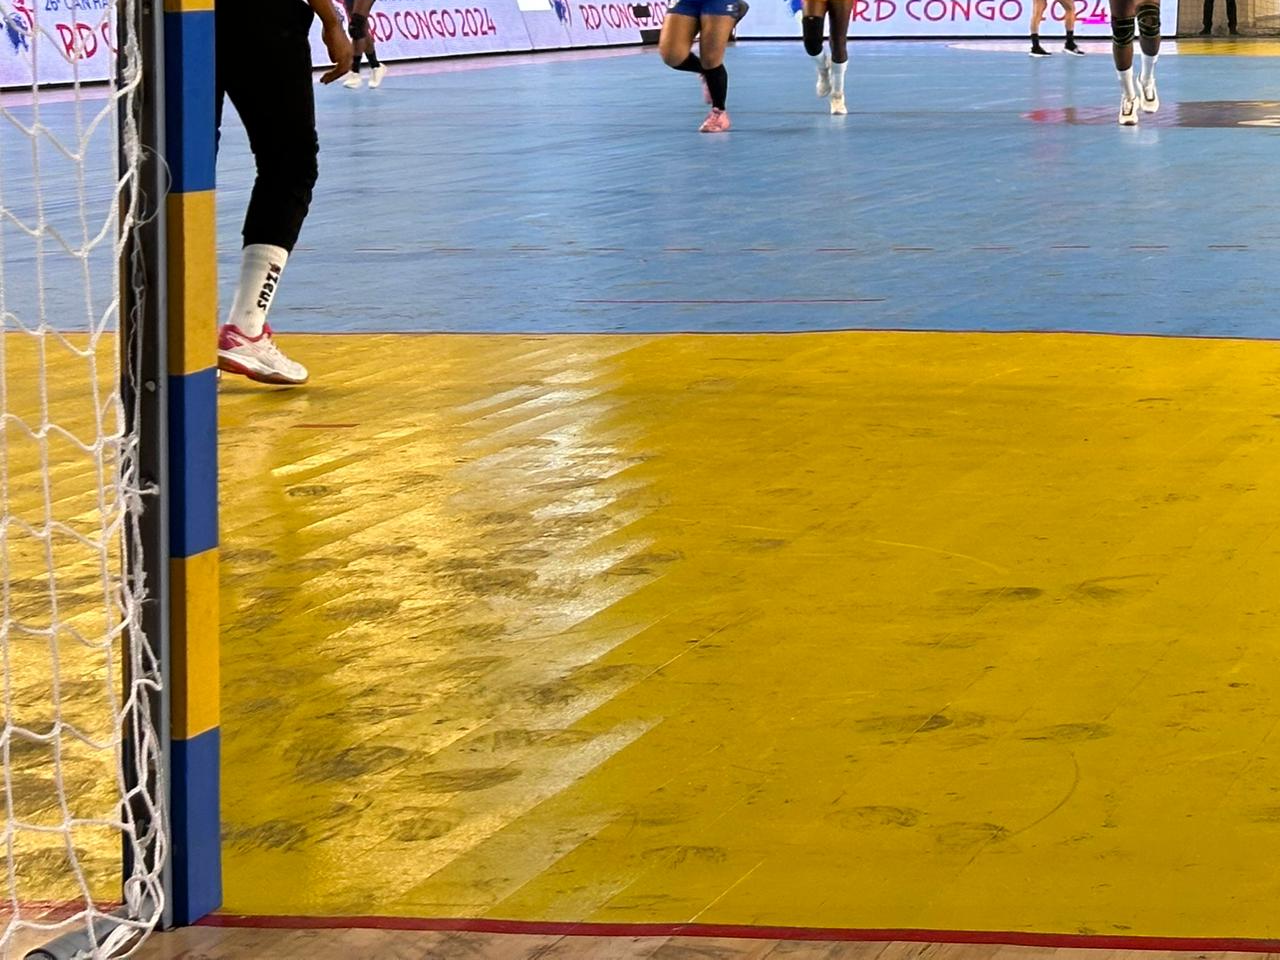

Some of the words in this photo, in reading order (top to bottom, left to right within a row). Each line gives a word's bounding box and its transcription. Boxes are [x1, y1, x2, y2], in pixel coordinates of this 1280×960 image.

[368, 11, 393, 42] RD
[394, 8, 457, 40] CONGO
[455, 6, 497, 36] 2024
[579, 4, 601, 30] RD
[55, 23, 98, 60] RD
